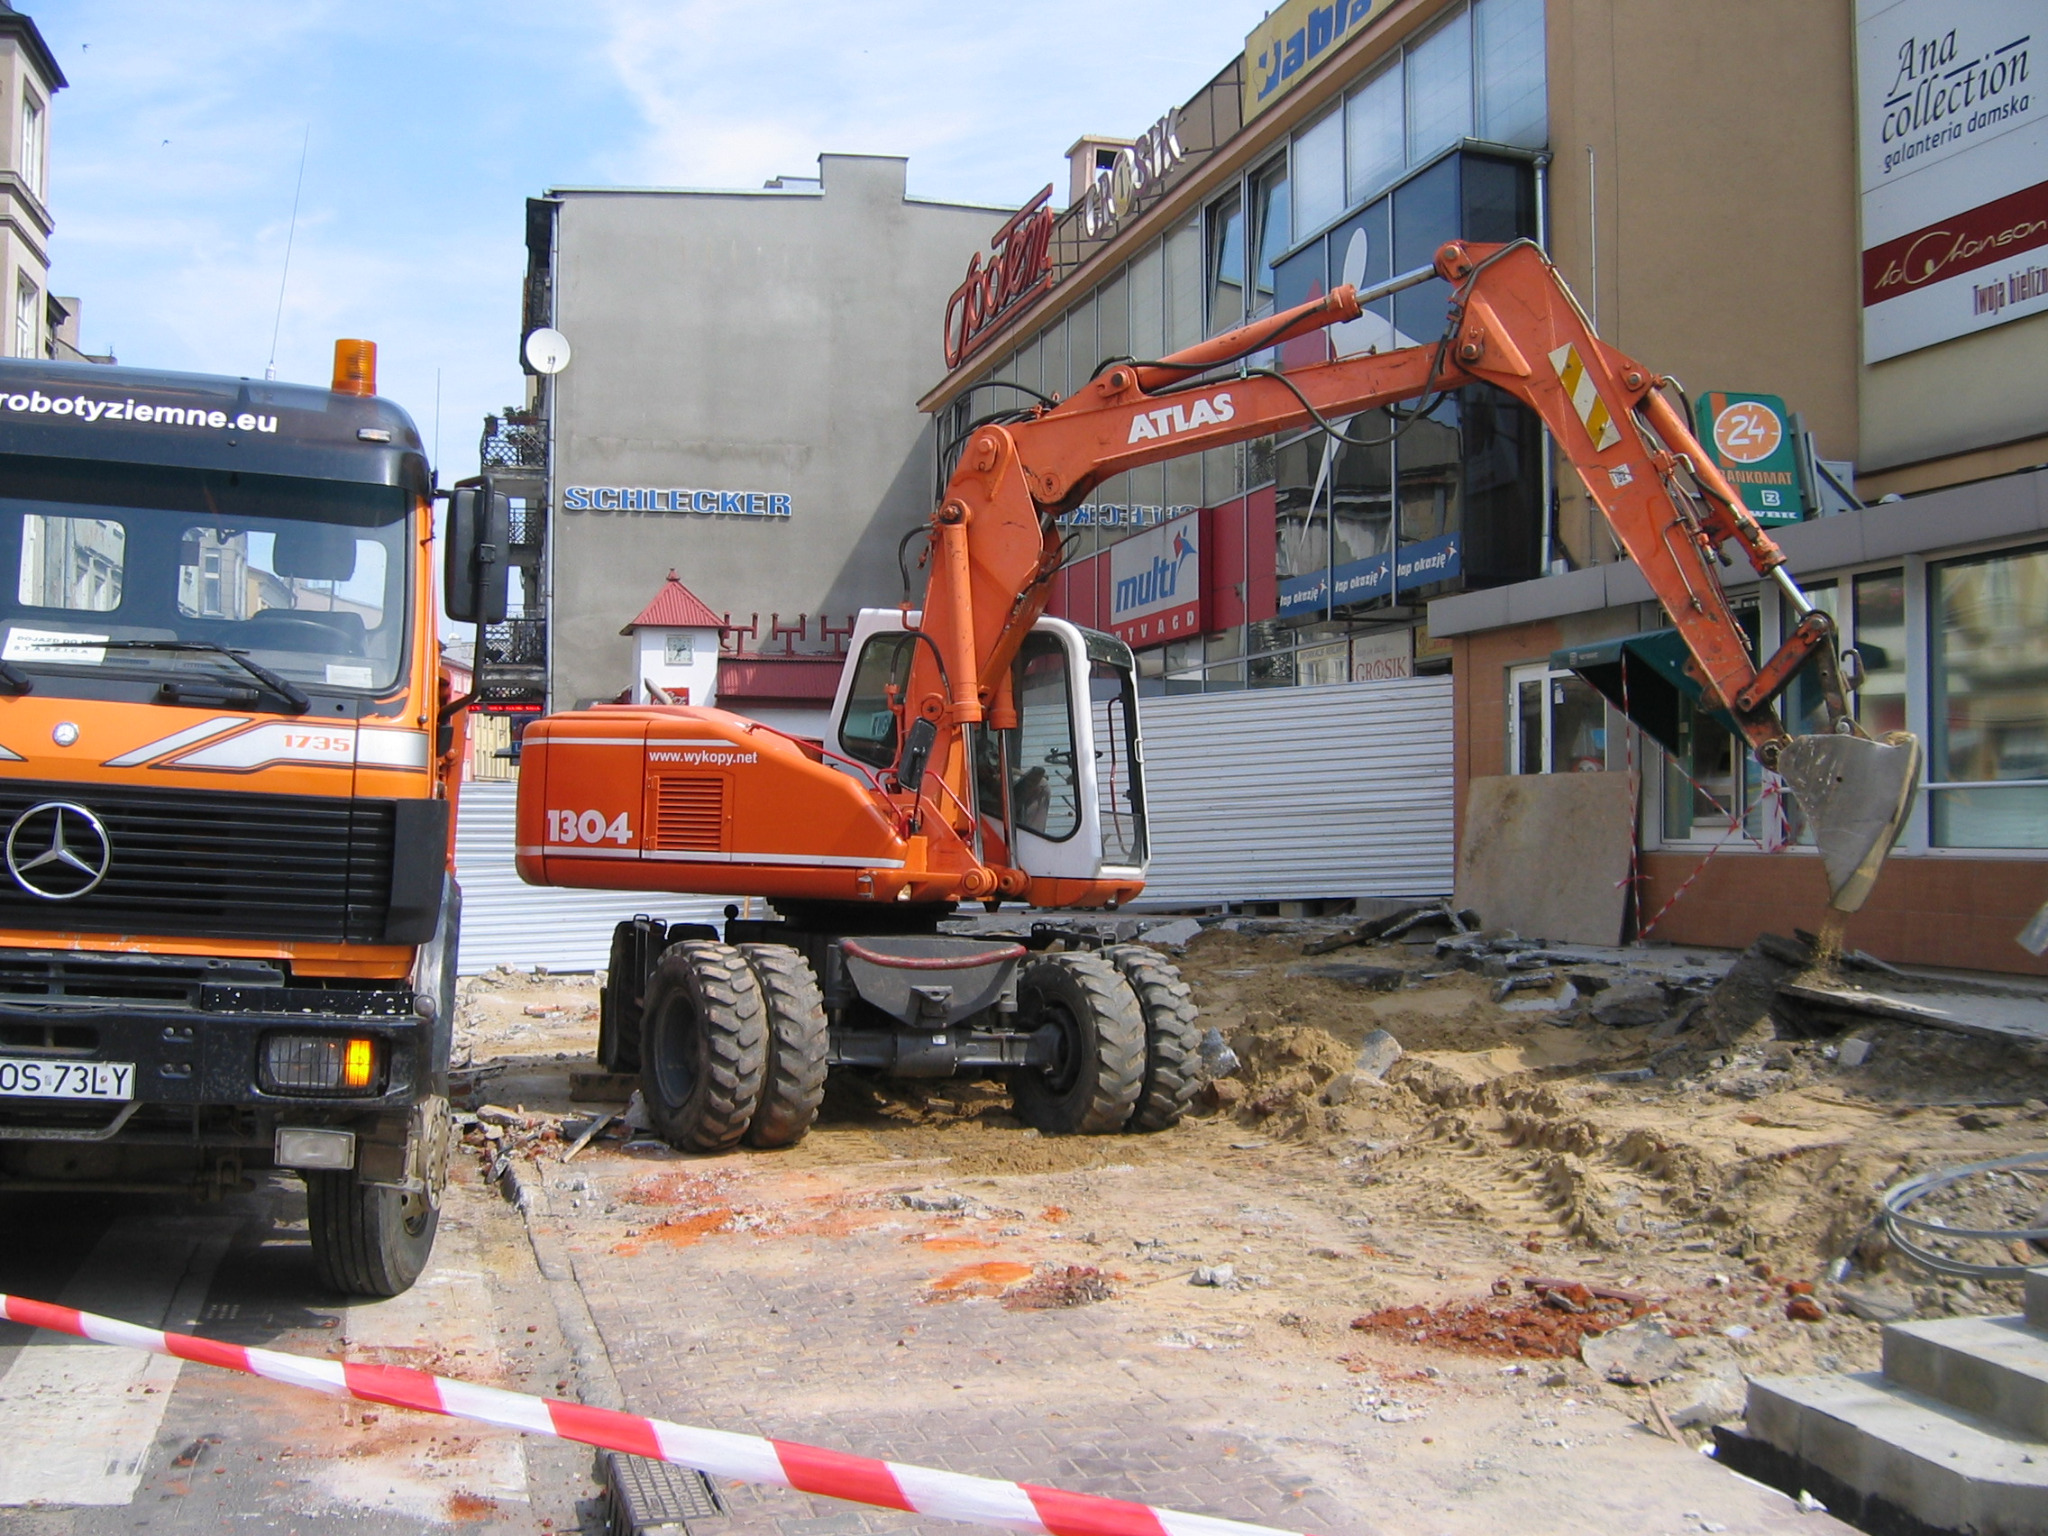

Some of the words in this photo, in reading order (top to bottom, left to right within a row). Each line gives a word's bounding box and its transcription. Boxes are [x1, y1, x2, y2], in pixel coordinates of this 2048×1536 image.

[1887, 28, 1957, 97] Ana
[1882, 50, 2030, 144] collection
[1884, 121, 1962, 174] galanteria
[1968, 95, 2030, 133] damska
[1084, 105, 1186, 238] GROSIK
[1973, 283, 2006, 316] Twoja
[1127, 393, 1235, 445] ATLAS
[1727, 414, 1765, 446] 24
[564, 486, 792, 517] SCHLECKER
[1115, 553, 1180, 613] multi
[1355, 656, 1407, 682] GROSIK
[284, 735, 350, 752] 1735
[649, 750, 758, 766] www.wykopy.net
[547, 809, 633, 844] 1304
[0, 1063, 42, 1092] OS
[53, 1065, 129, 1096] 73LY
